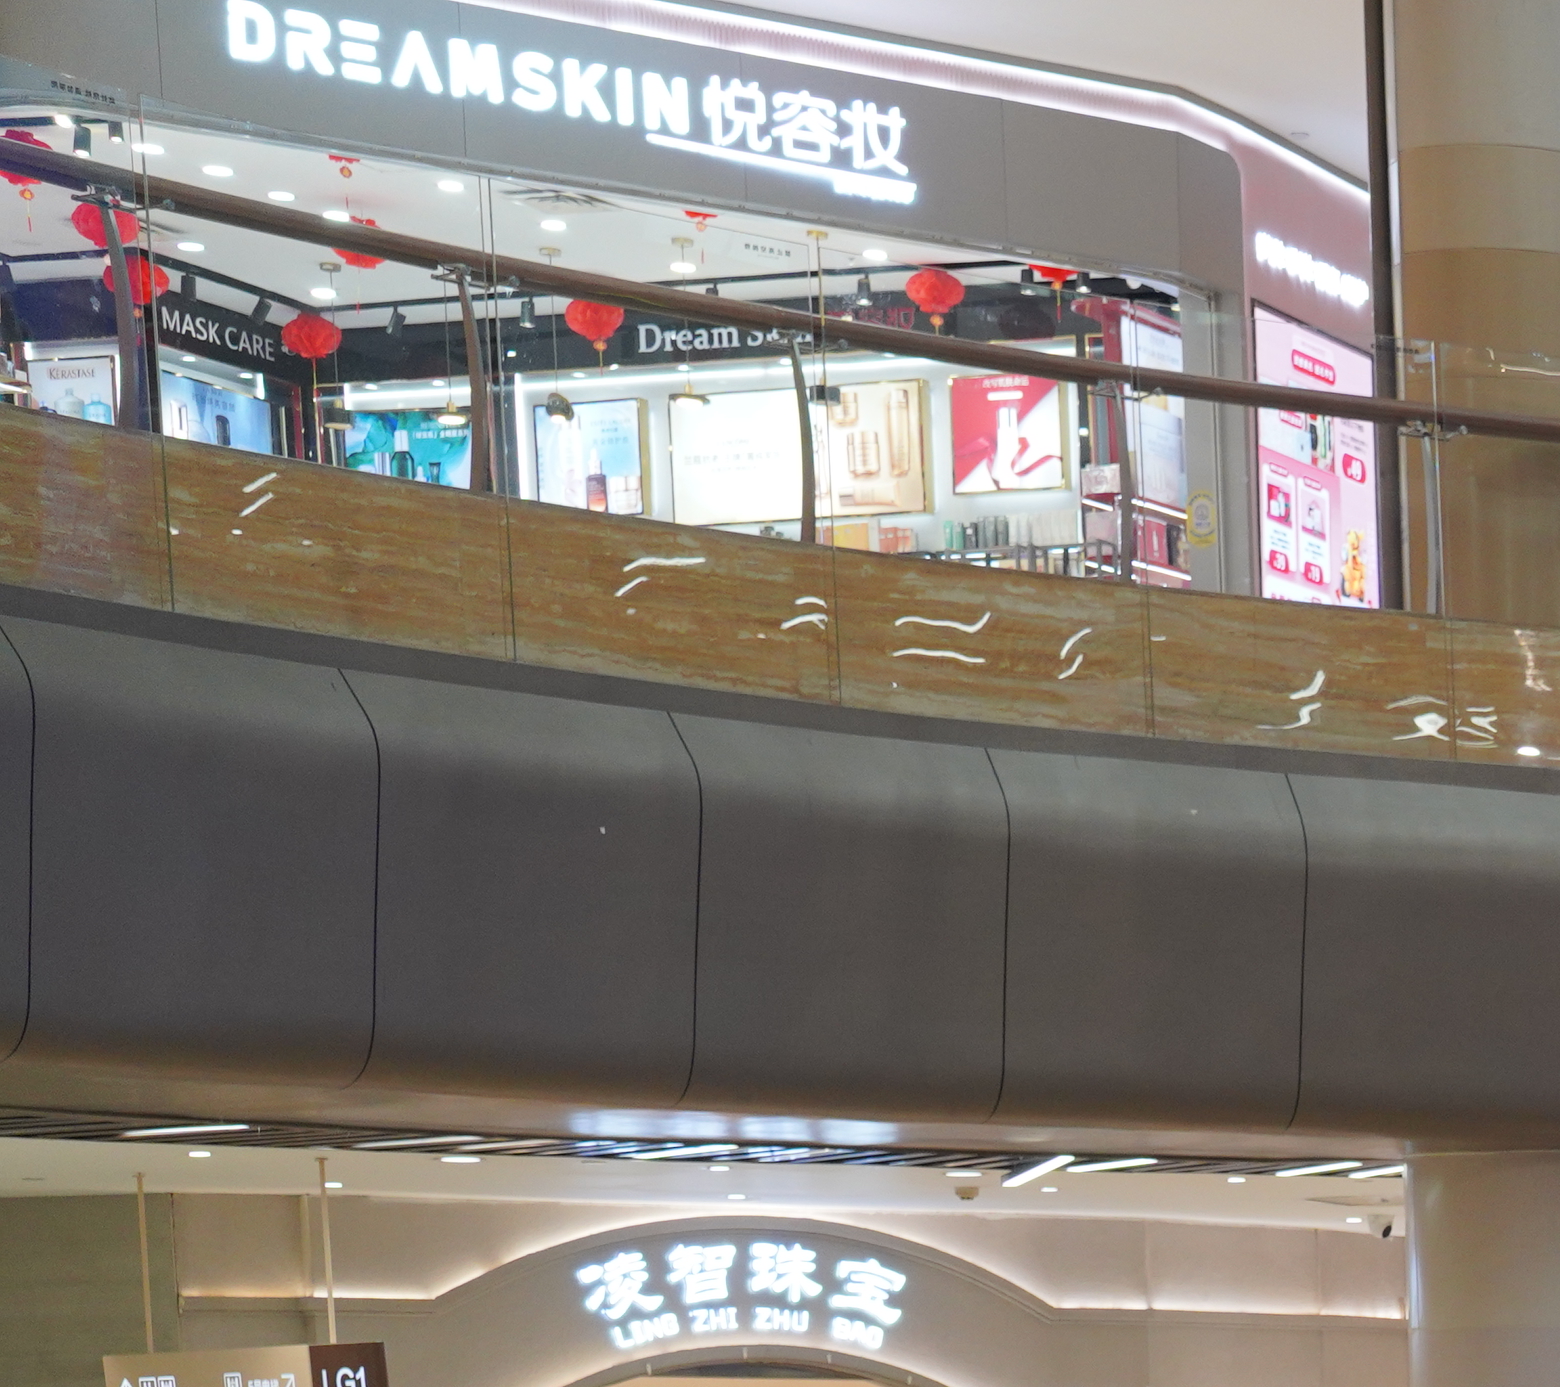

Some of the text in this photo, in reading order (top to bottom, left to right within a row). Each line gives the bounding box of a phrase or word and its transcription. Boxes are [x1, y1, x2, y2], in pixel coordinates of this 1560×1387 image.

[227, 0, 910, 176] DREAMSKIN 悦容妆
[161, 305, 276, 362] MASK CARE
[638, 323, 740, 355] Dream
[610, 1312, 682, 1349] LING
[691, 1305, 738, 1335] ZHI
[753, 1305, 810, 1334] ZHU
